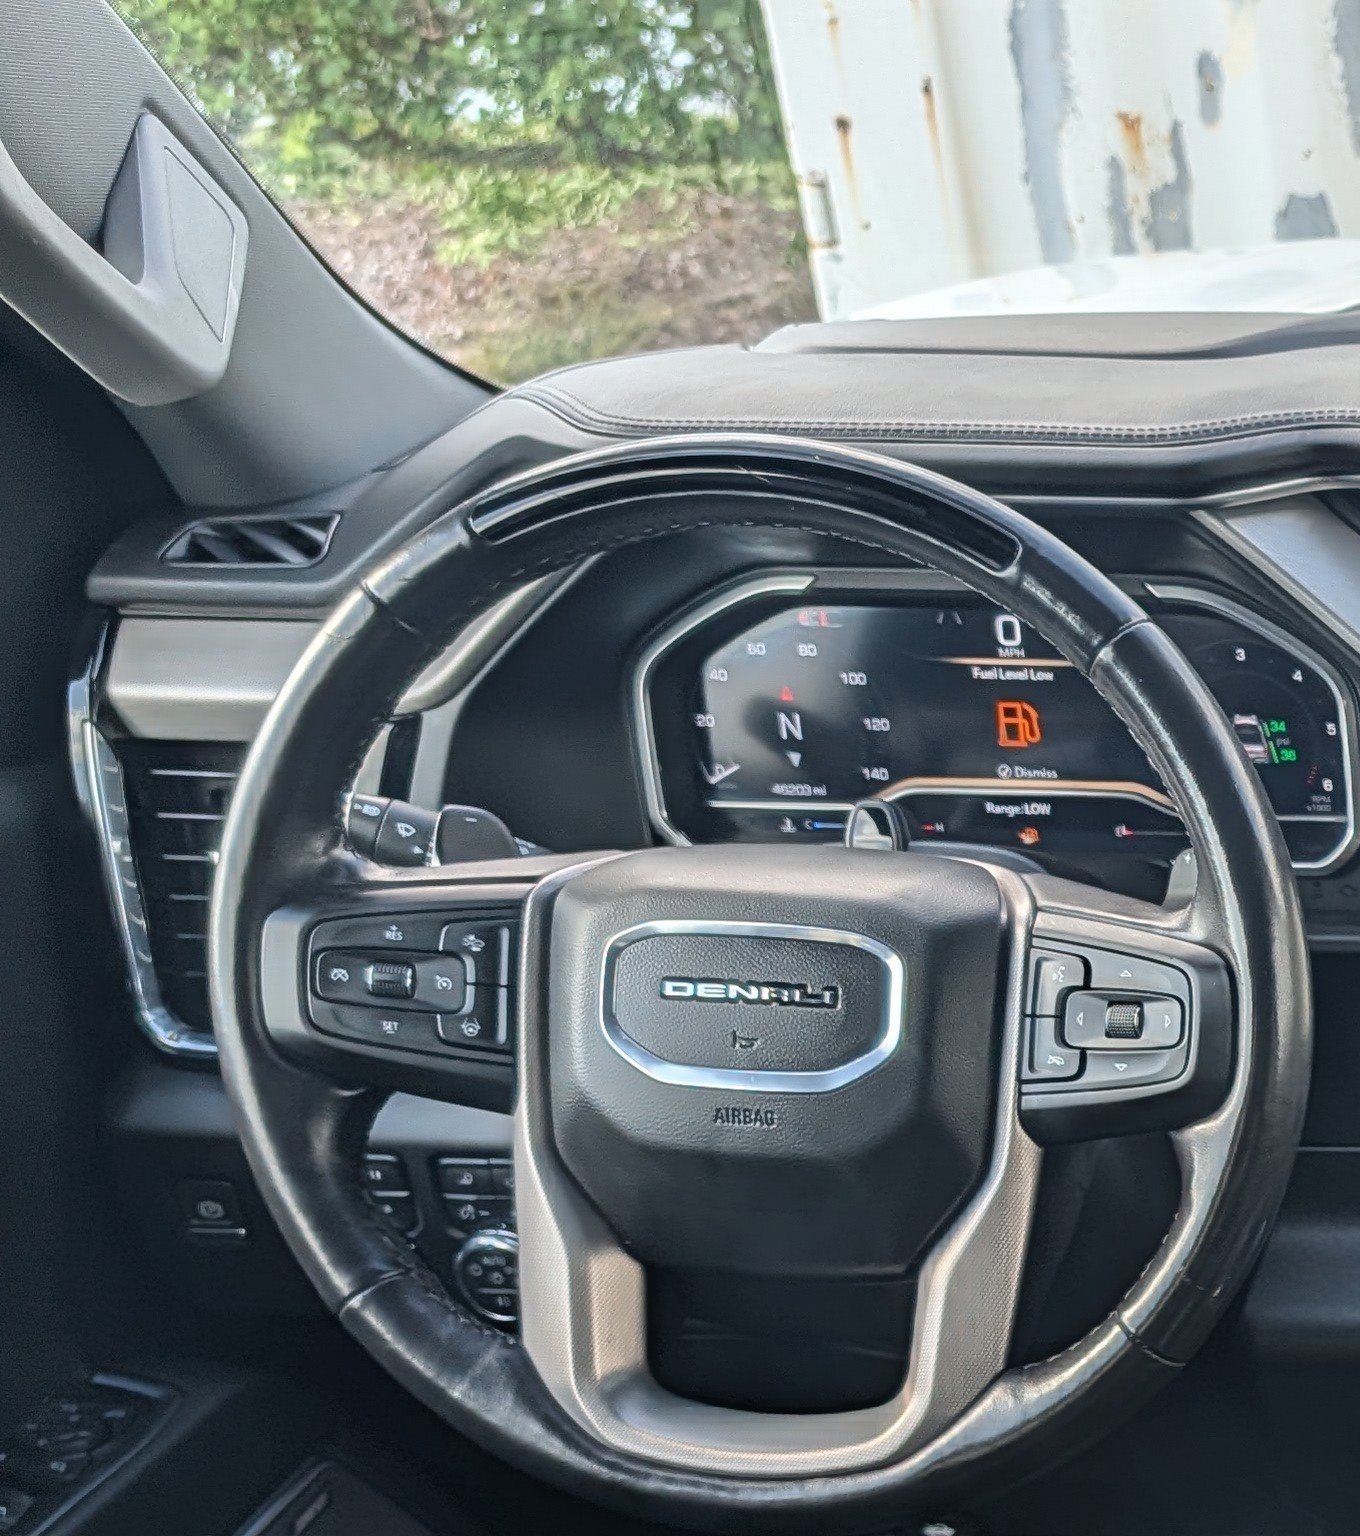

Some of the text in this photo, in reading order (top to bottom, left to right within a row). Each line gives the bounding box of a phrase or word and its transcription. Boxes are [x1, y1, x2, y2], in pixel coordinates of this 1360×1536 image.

[994, 613, 1022, 647] 0
[998, 647, 1025, 658] MPH
[1234, 648, 1246, 662] 3
[839, 671, 868, 686] 100
[971, 666, 1054, 682] Fuel Level Low
[1292, 669, 1303, 682] 4
[776, 711, 804, 741] N
[862, 717, 891, 732] 120
[1325, 721, 1337, 736] 5
[1013, 766, 1058, 780] Dismiss
[662, 979, 834, 1005] DENALI
[382, 1021, 399, 1031] SET
[713, 1108, 777, 1128] AIRBAG
